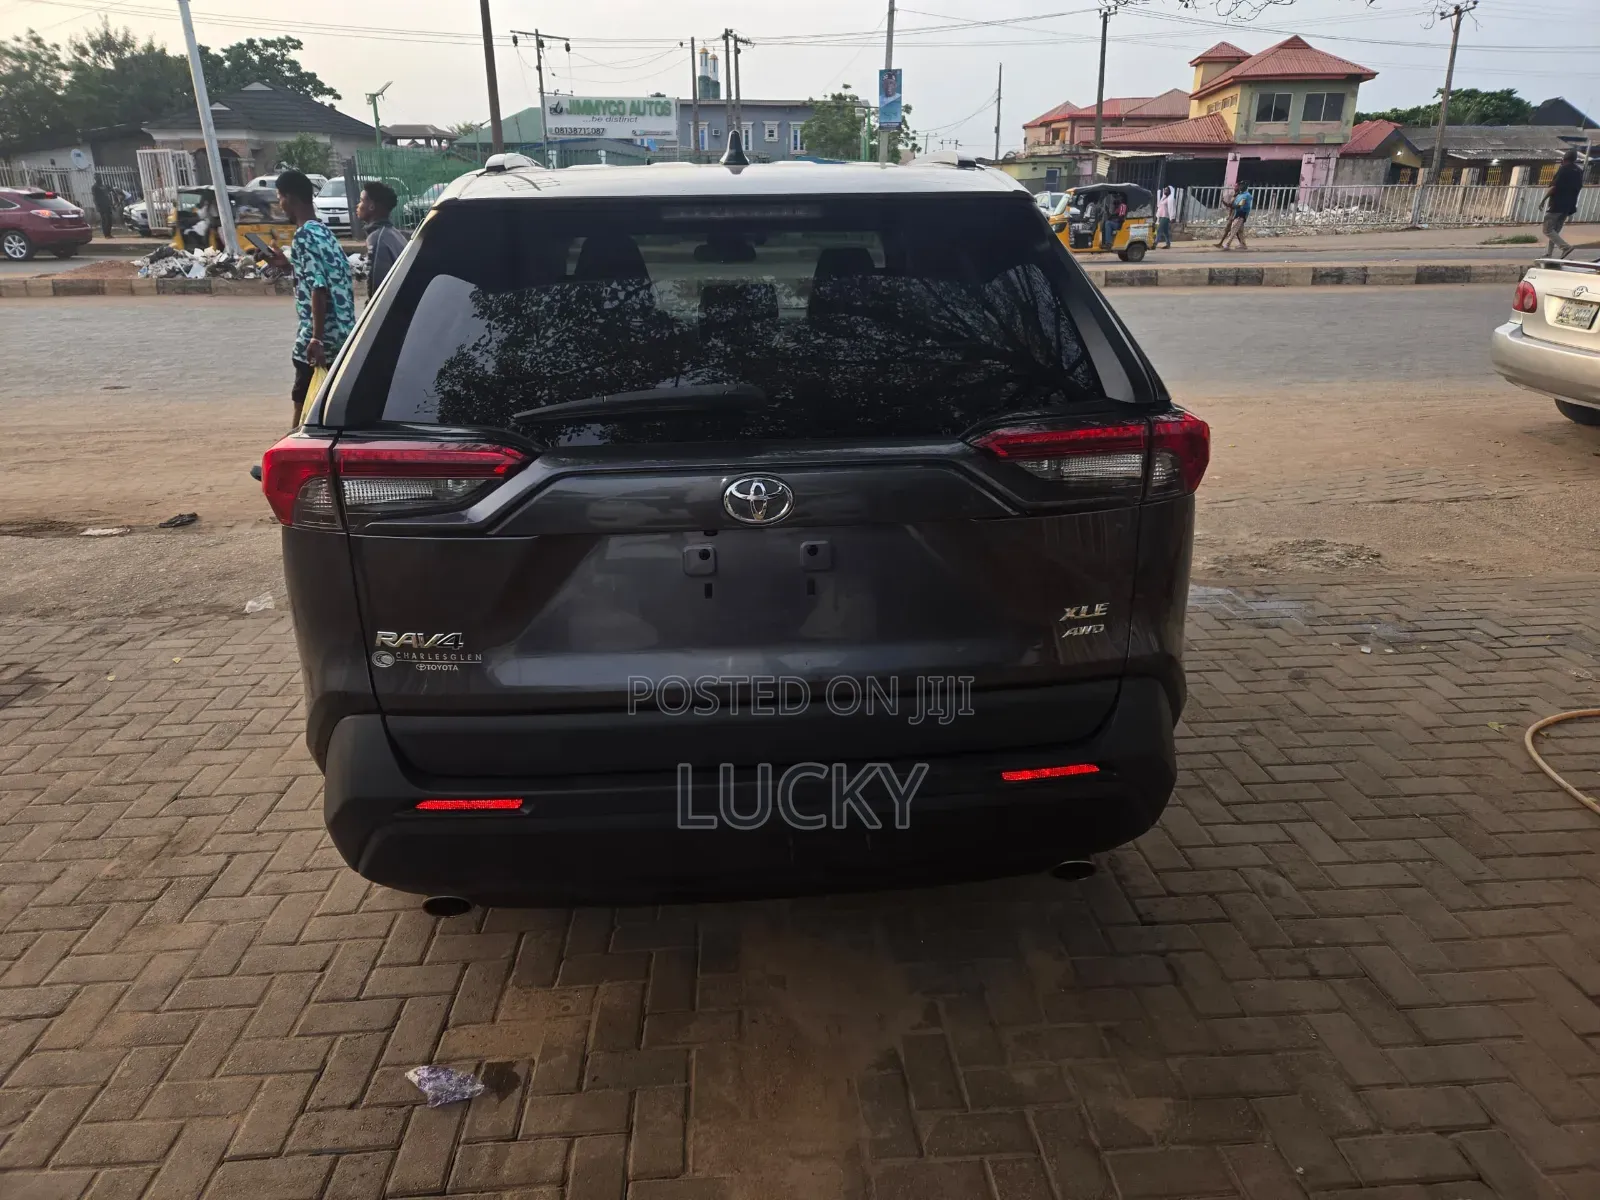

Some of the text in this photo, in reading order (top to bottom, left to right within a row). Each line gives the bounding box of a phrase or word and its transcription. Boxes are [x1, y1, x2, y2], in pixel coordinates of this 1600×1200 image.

[629, 99, 672, 117] AUTOS
[605, 115, 638, 123] distinct
[1059, 602, 1110, 621] XLE
[1061, 623, 1105, 639] AWD
[375, 630, 464, 651] RAV4
